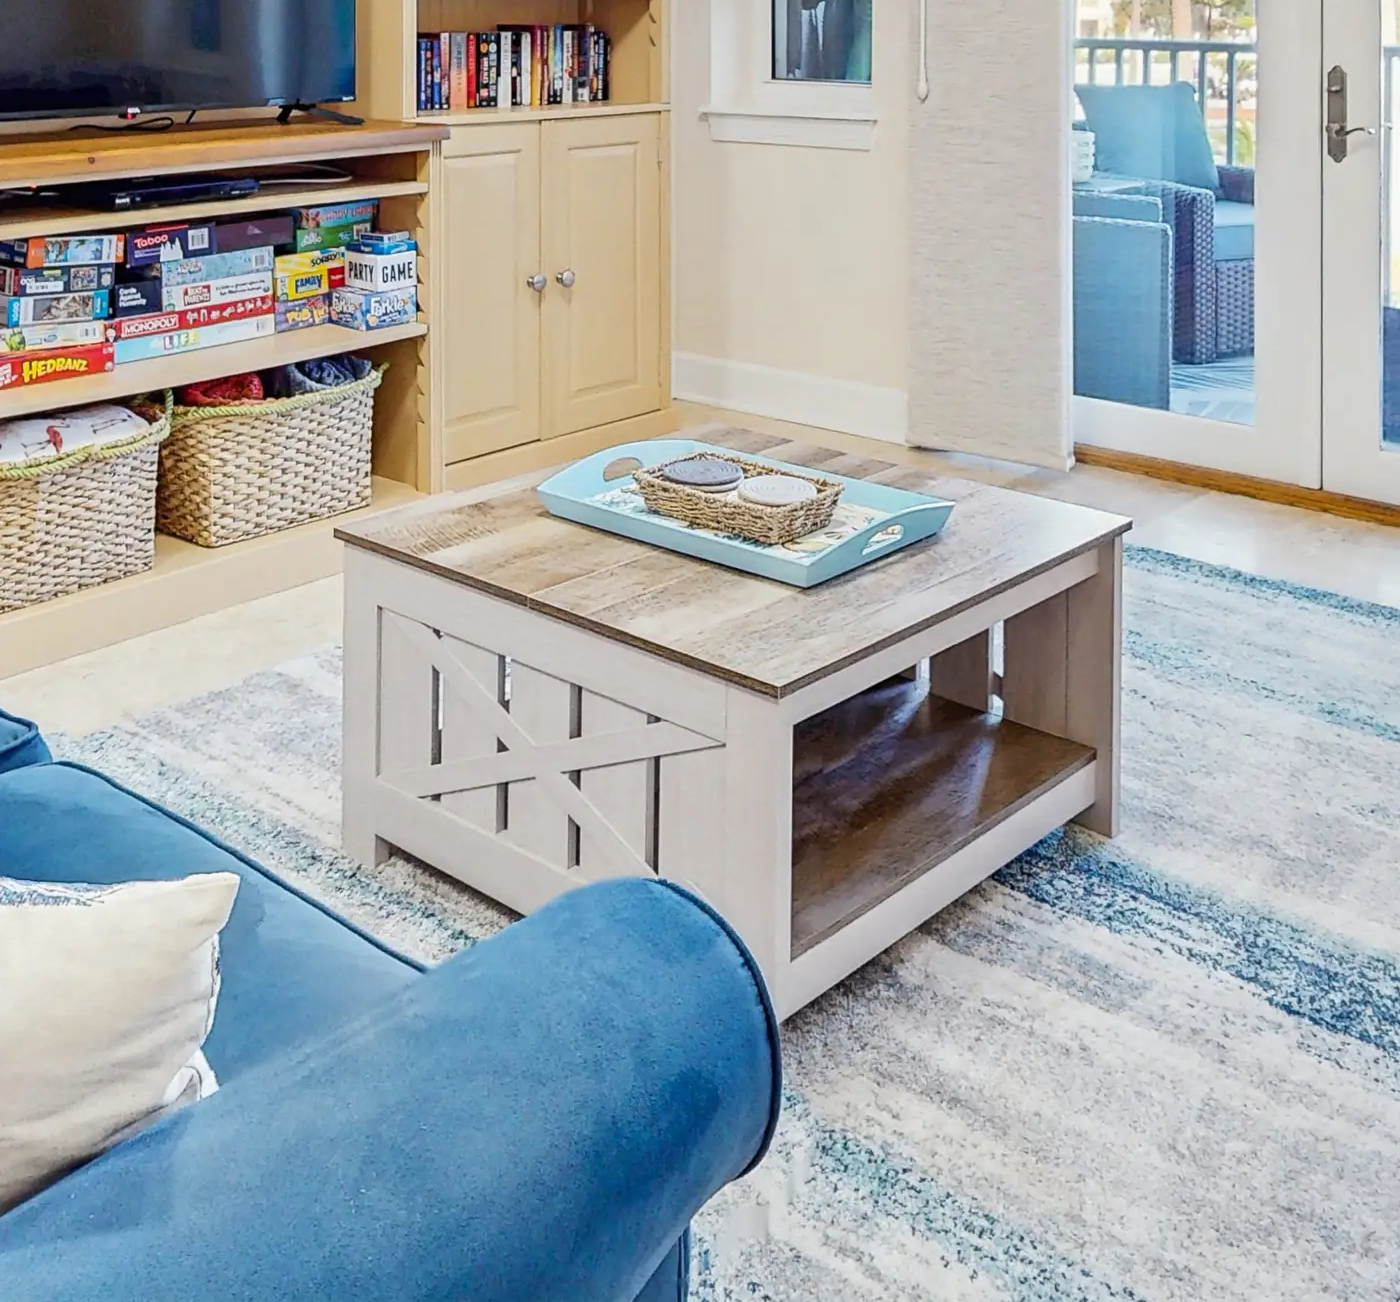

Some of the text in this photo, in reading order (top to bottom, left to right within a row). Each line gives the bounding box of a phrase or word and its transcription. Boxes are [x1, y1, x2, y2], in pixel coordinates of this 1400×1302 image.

[134, 234, 169, 249] Taboo
[348, 260, 414, 284] PARTY GAME
[332, 292, 356, 313] Farkle
[370, 294, 404, 316] Farkle
[123, 316, 177, 335] MONOPOLY
[164, 332, 199, 350] LIFE
[22, 357, 88, 383] HEDBANZ
